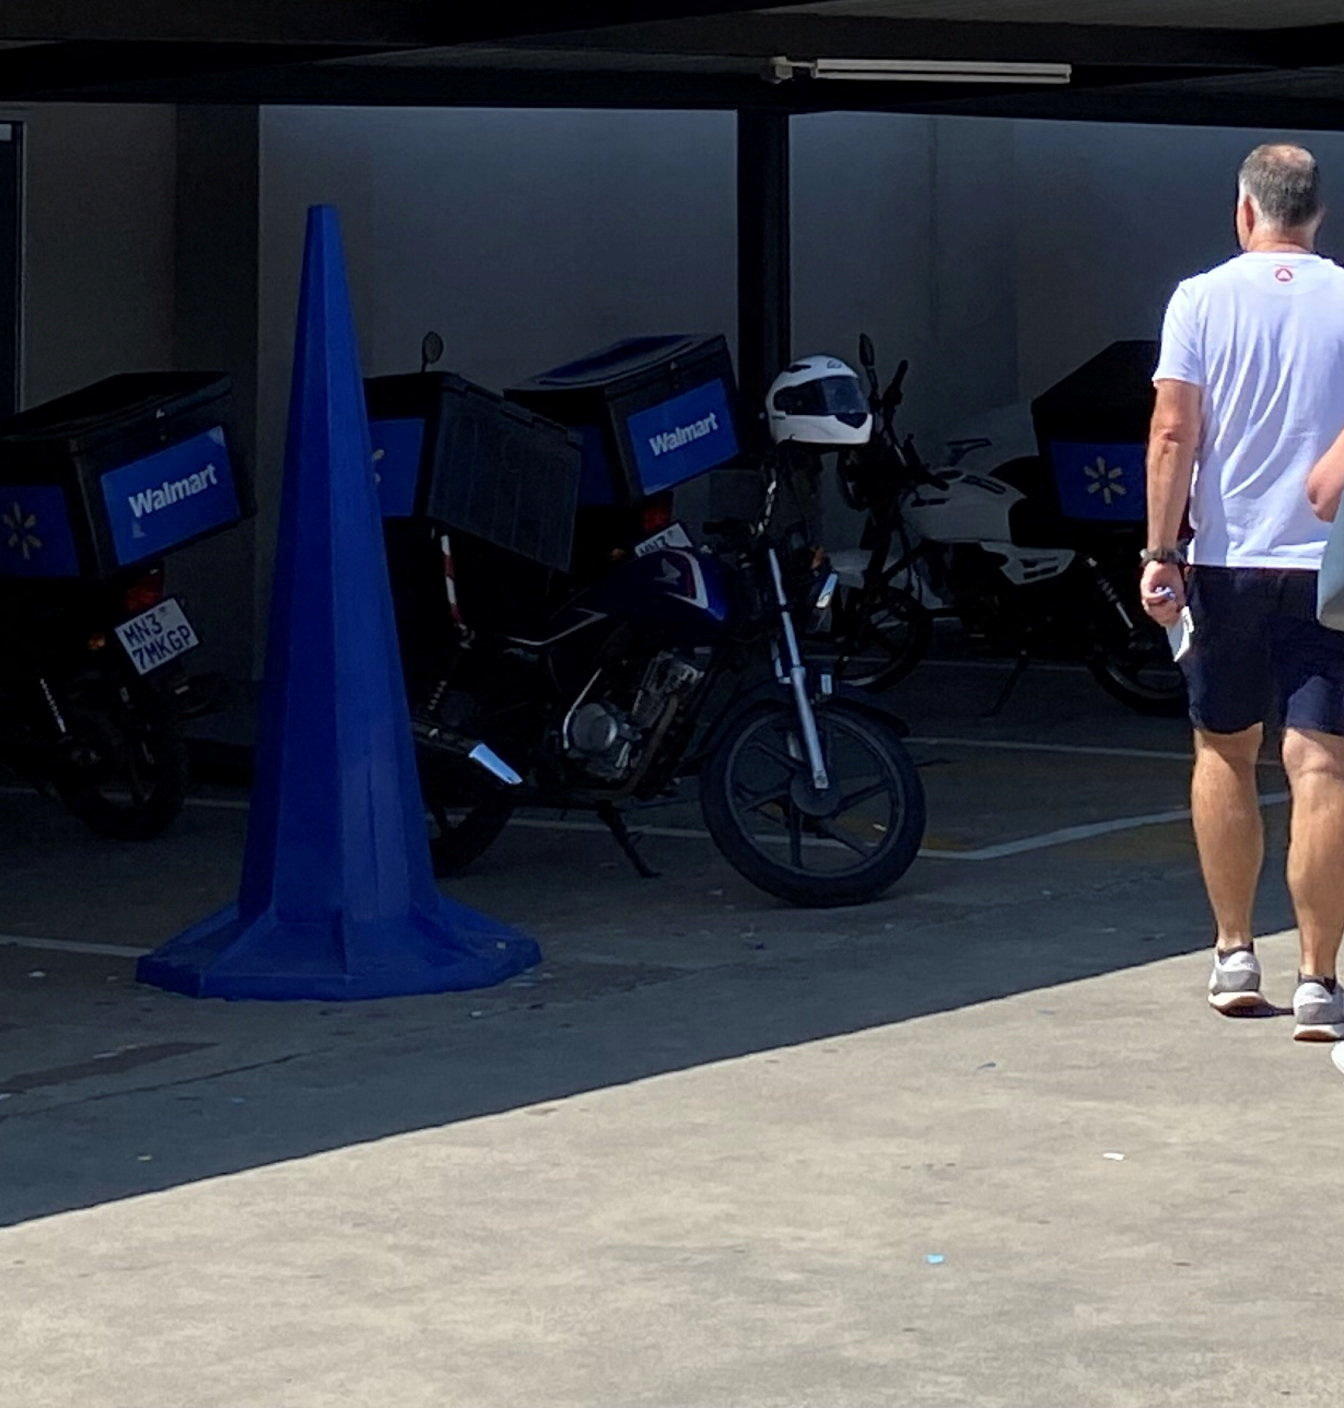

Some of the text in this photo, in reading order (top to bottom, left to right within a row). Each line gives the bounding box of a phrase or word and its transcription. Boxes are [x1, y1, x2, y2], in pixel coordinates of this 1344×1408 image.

[648, 412, 719, 457] Walmart
[128, 463, 218, 519] Walmart
[122, 612, 163, 648] MN3
[131, 625, 192, 671] 7MKGP
